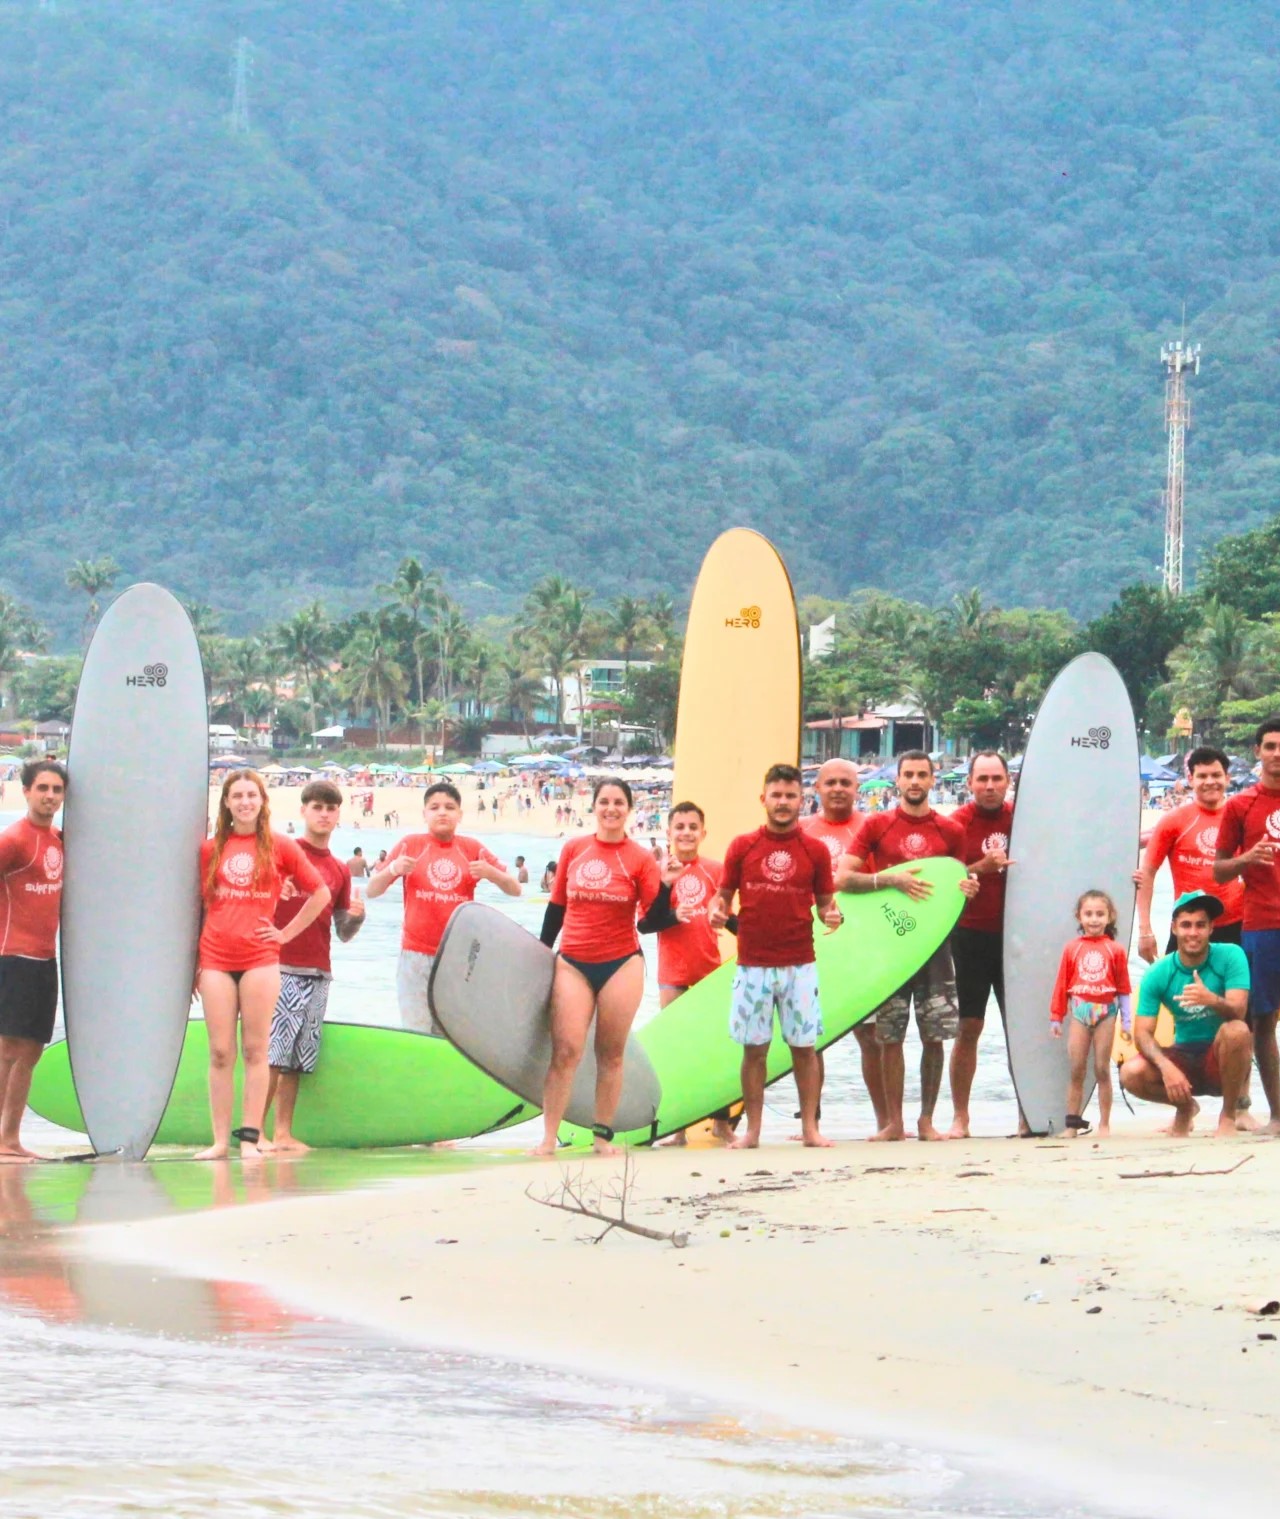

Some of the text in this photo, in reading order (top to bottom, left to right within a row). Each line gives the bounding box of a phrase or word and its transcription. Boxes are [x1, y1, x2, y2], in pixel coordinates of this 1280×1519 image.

[725, 617, 761, 629] HERO
[126, 675, 167, 688] HERO
[1071, 736, 1109, 750] HERO
[1178, 855, 1203, 866] SURF
[24, 882, 48, 895] SURF
[578, 890, 601, 902] PARA
[600, 891, 629, 902] TODOS
[880, 902, 906, 936] HERO
